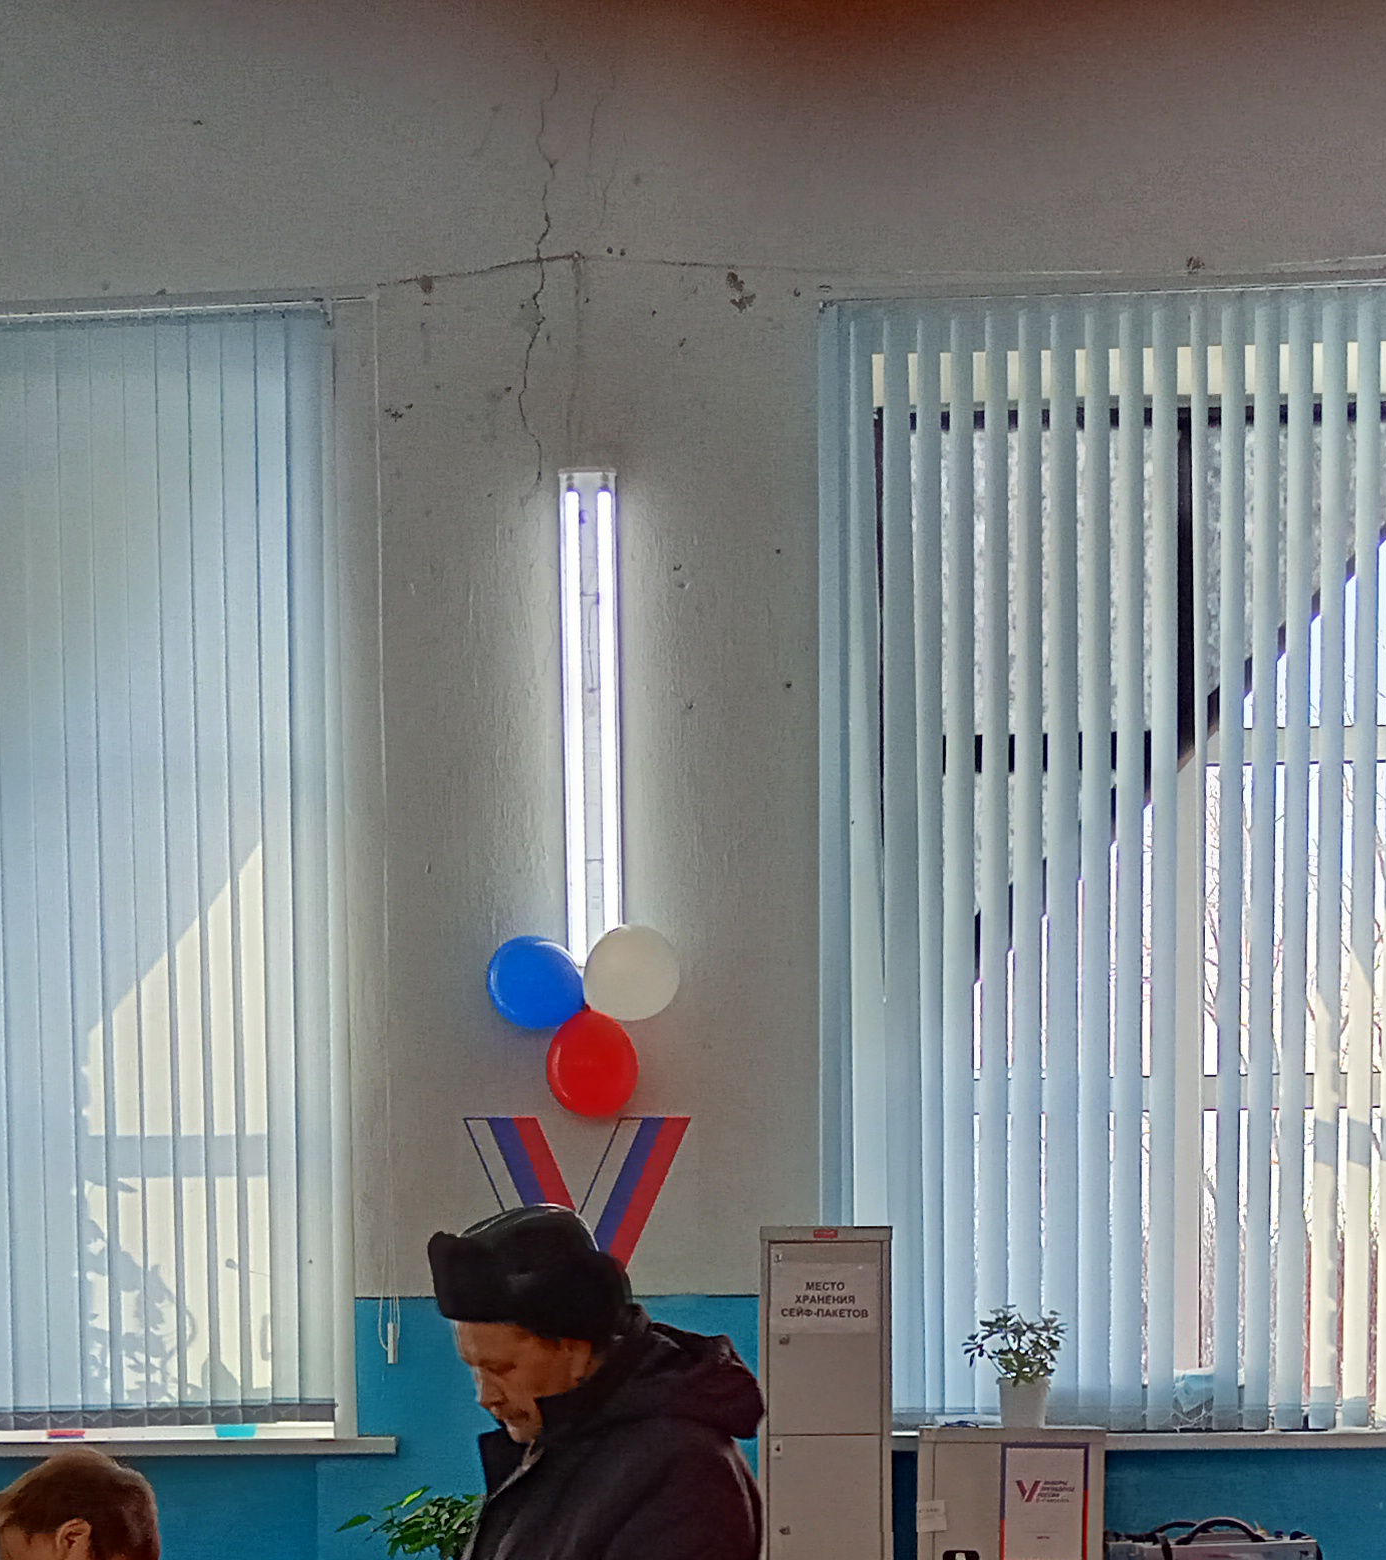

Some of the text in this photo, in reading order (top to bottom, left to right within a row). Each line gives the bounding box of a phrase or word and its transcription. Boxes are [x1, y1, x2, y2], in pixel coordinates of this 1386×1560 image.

[805, 1281, 845, 1291] МЕСТО
[794, 1294, 856, 1305] ХРАНЕНИЯ
[780, 1307, 870, 1319] СЕЙФ-ПАКЕТОВ
